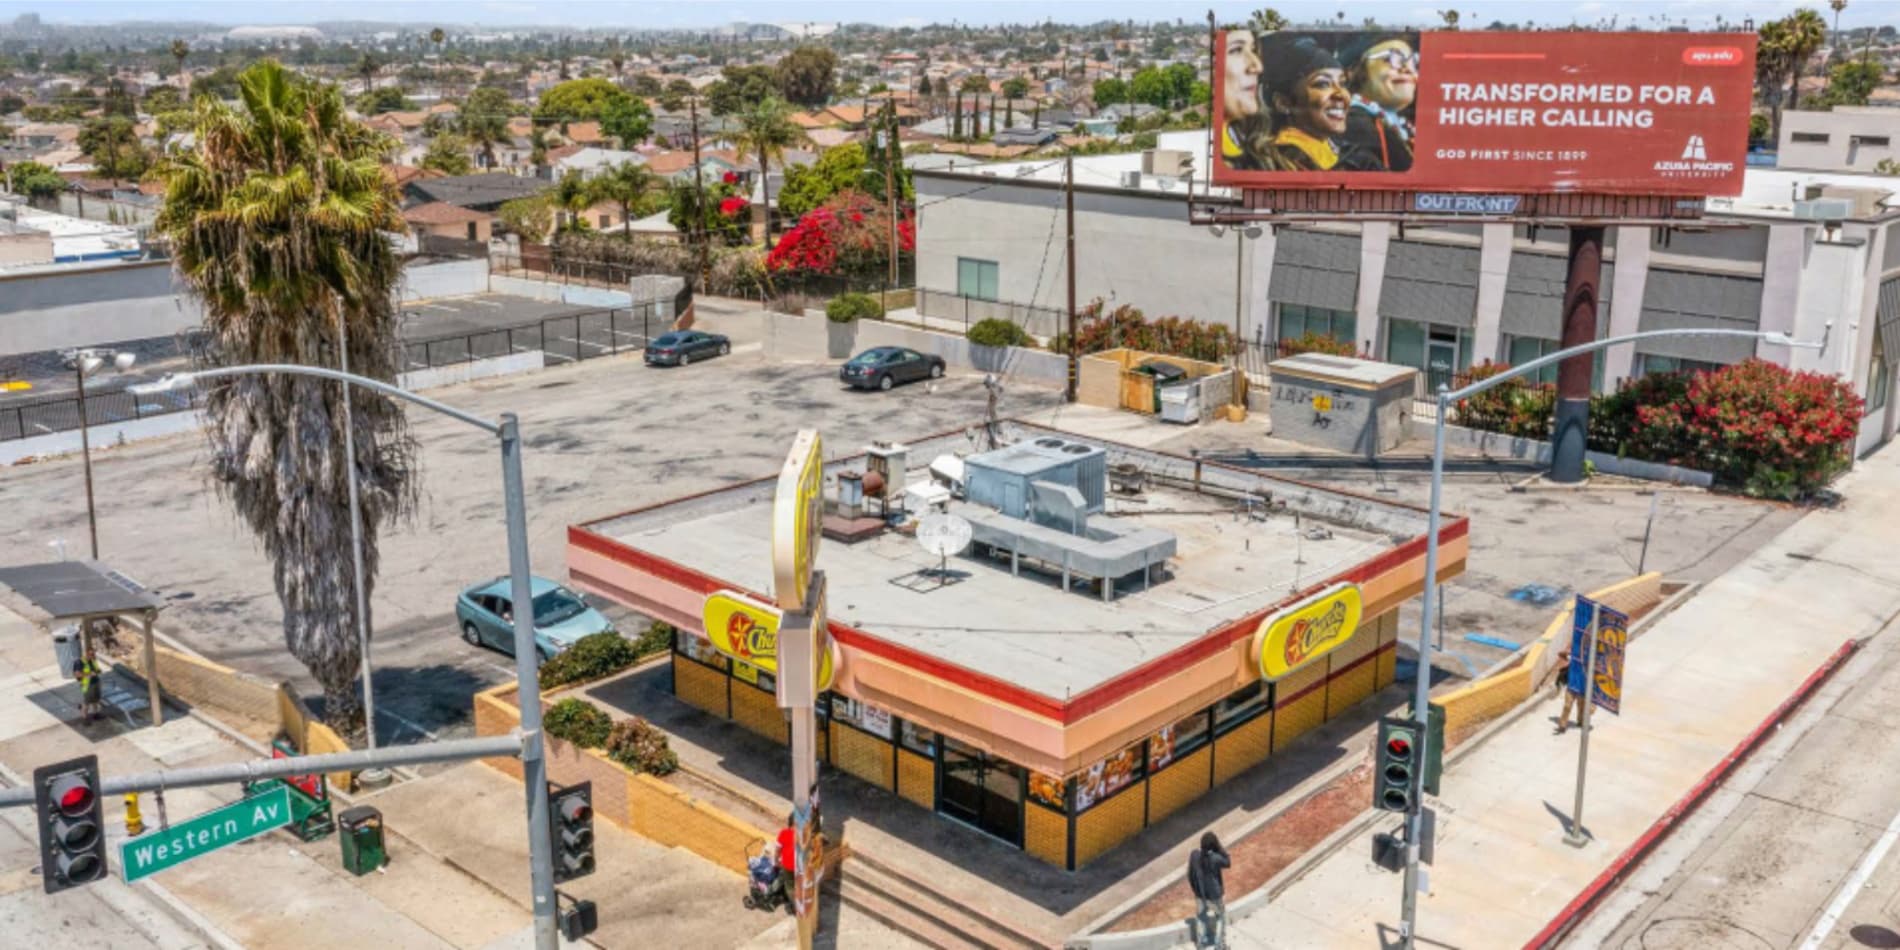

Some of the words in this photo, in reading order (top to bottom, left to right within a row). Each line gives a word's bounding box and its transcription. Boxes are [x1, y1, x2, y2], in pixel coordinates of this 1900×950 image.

[1440, 83, 1633, 104] TRANSFORMED
[1639, 85, 1692, 104] FOR
[1696, 86, 1716, 104] A
[1439, 107, 1537, 126] HIGHER
[1542, 108, 1654, 128] CALLING
[1435, 149, 1467, 160] GOD
[1470, 149, 1510, 160] FIRST
[1513, 150, 1554, 161] SINCE
[1558, 151, 1588, 161] 1899
[1653, 161, 1691, 171] AZUSA
[1692, 161, 1734, 172] PACIFIC
[134, 819, 238, 869] Western
[252, 802, 279, 827] Av
